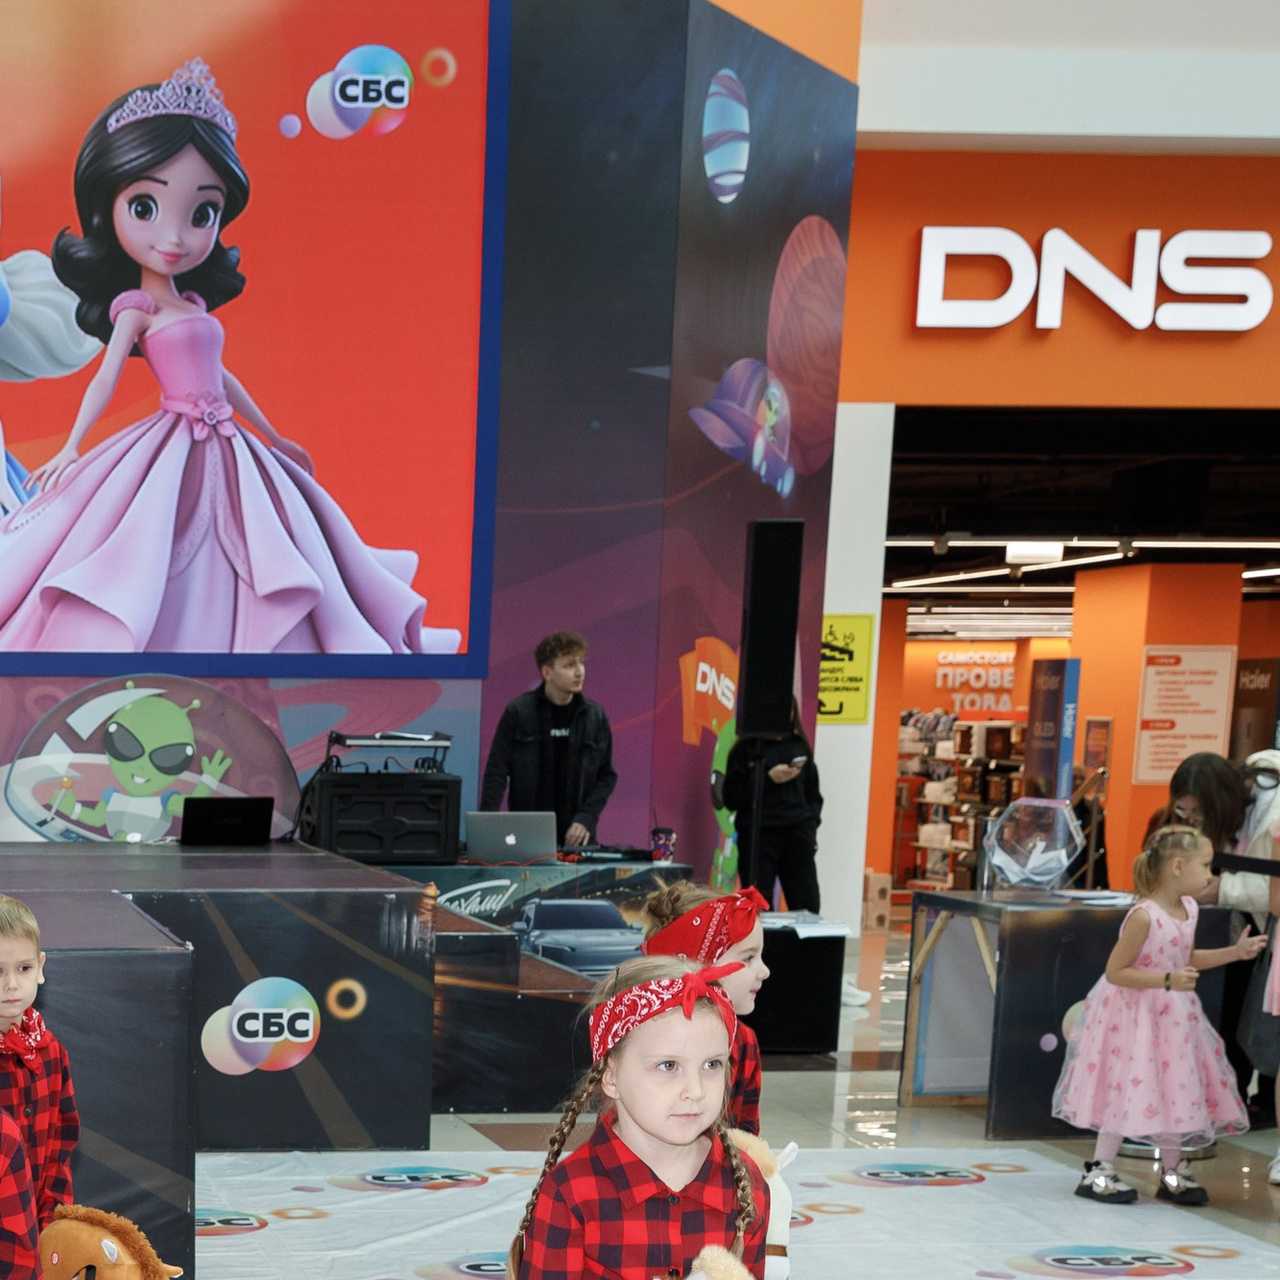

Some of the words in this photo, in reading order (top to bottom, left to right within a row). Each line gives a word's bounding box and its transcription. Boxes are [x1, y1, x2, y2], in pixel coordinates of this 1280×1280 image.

[338, 78, 405, 103] СБС
[916, 226, 1274, 332] DNS
[696, 661, 735, 711] DNS
[236, 1011, 311, 1039] СБС
[1049, 1254, 1178, 1268] СБС
